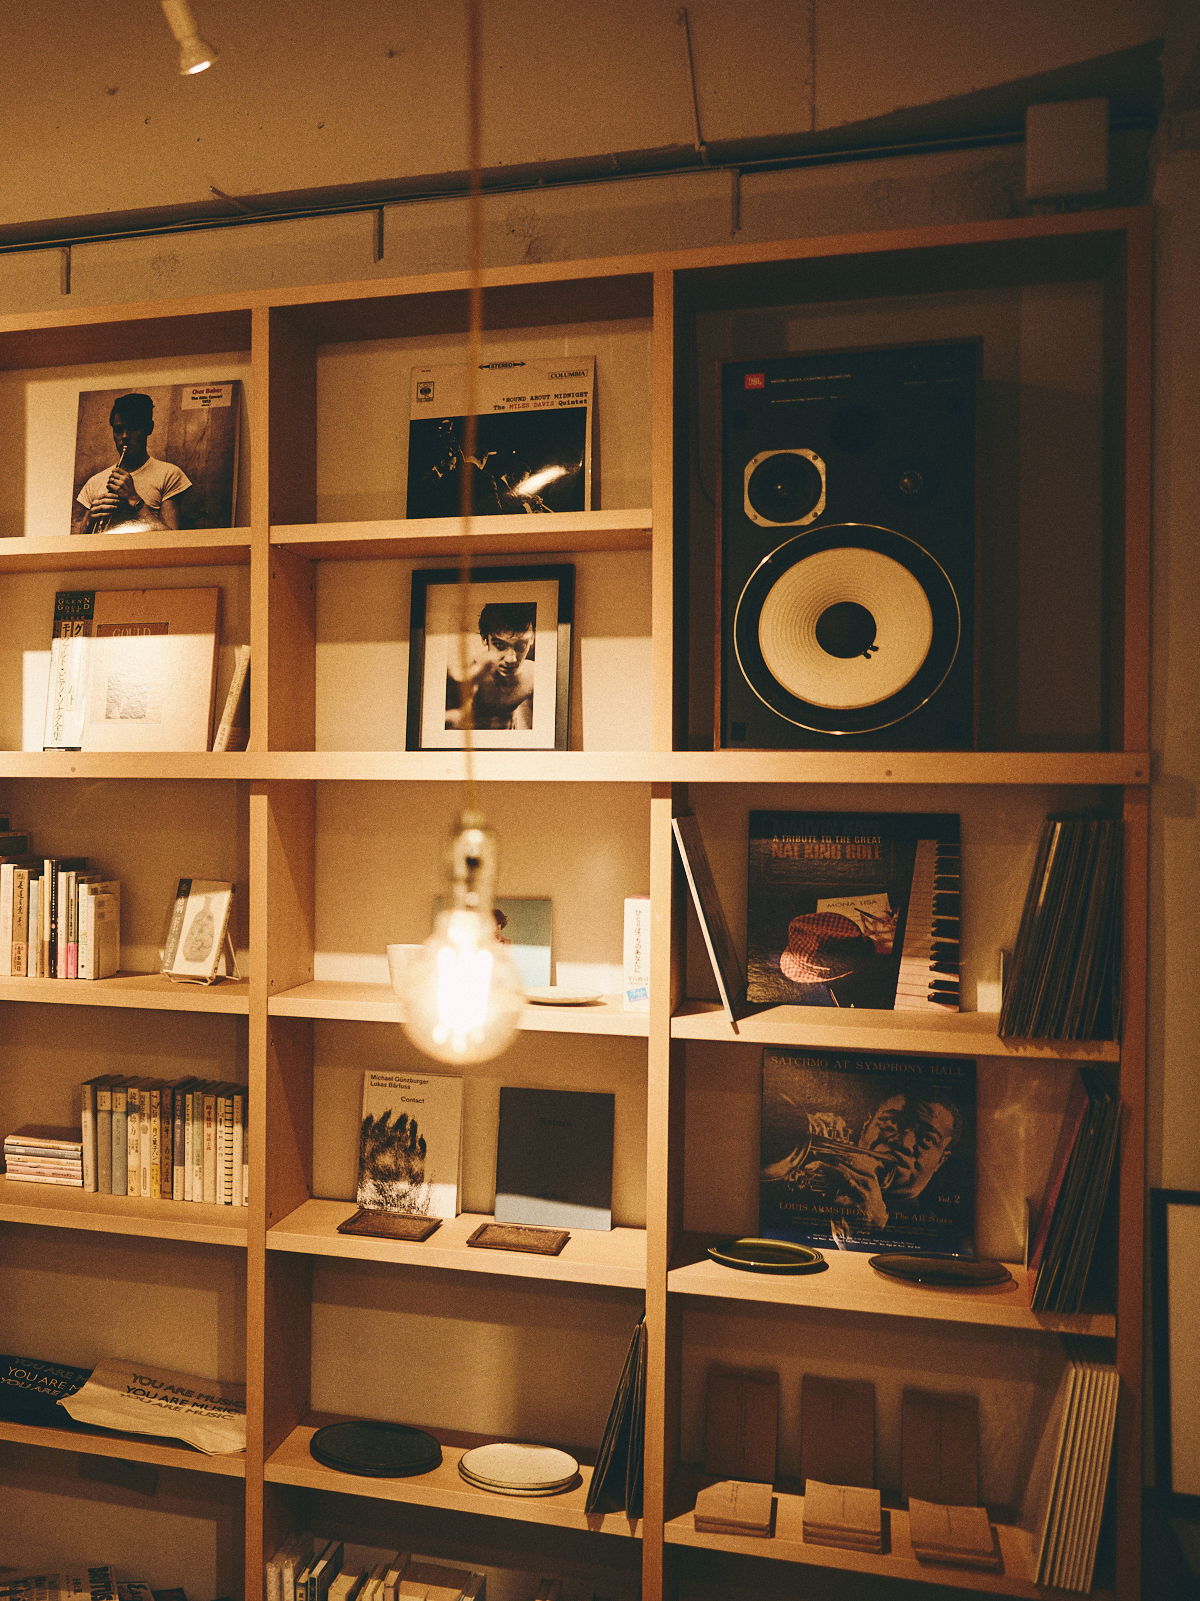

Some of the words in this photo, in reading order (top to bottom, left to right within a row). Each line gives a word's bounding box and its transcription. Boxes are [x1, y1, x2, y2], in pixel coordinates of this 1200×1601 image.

[551, 370, 586, 380] COLUMBIA
[530, 394, 551, 402] ABOUT
[554, 391, 588, 400] MIDNIGHT
[534, 400, 555, 408] DAVIS
[559, 398, 588, 407] Quintet
[57, 597, 91, 606] GLENN
[57, 603, 91, 611] GOULD
[772, 835, 780, 843] A
[781, 835, 818, 843] TRIBUTE
[820, 836, 833, 844] TO
[835, 836, 852, 844] THE
[854, 836, 883, 844] GREAT
[771, 843, 800, 859] NAT
[803, 844, 842, 860] KING
[845, 844, 883, 860] COLE
[770, 1055, 829, 1067] SATCHMO
[833, 1059, 850, 1069] AT
[855, 1060, 925, 1075] SYMPHONY
[930, 1065, 966, 1077] HALL
[388, 1082, 411, 1090] Bärfuss
[394, 1076, 429, 1086] Günzburger
[400, 1096, 425, 1104] Contact
[938, 1195, 951, 1204] Vol.
[953, 1195, 961, 1204] 2
[778, 1202, 809, 1212] LOUIS
[811, 1204, 873, 1217] ARMSTRONG
[894, 1211, 909, 1220] The
[912, 1213, 926, 1222] All
[929, 1214, 953, 1224] Stars
[14, 1357, 46, 1370] YOU
[43, 1366, 75, 1380] ARE
[7, 1365, 39, 1382] YOU
[37, 1376, 68, 1390] ARE
[0, 1376, 32, 1389] YOU
[30, 1385, 62, 1397] ARE
[131, 1372, 165, 1389] YOU
[166, 1384, 194, 1399] ARE
[125, 1385, 159, 1400] YOU
[158, 1393, 190, 1406] ARE
[120, 1393, 154, 1406] YOU
[153, 1401, 182, 1413] ARE
